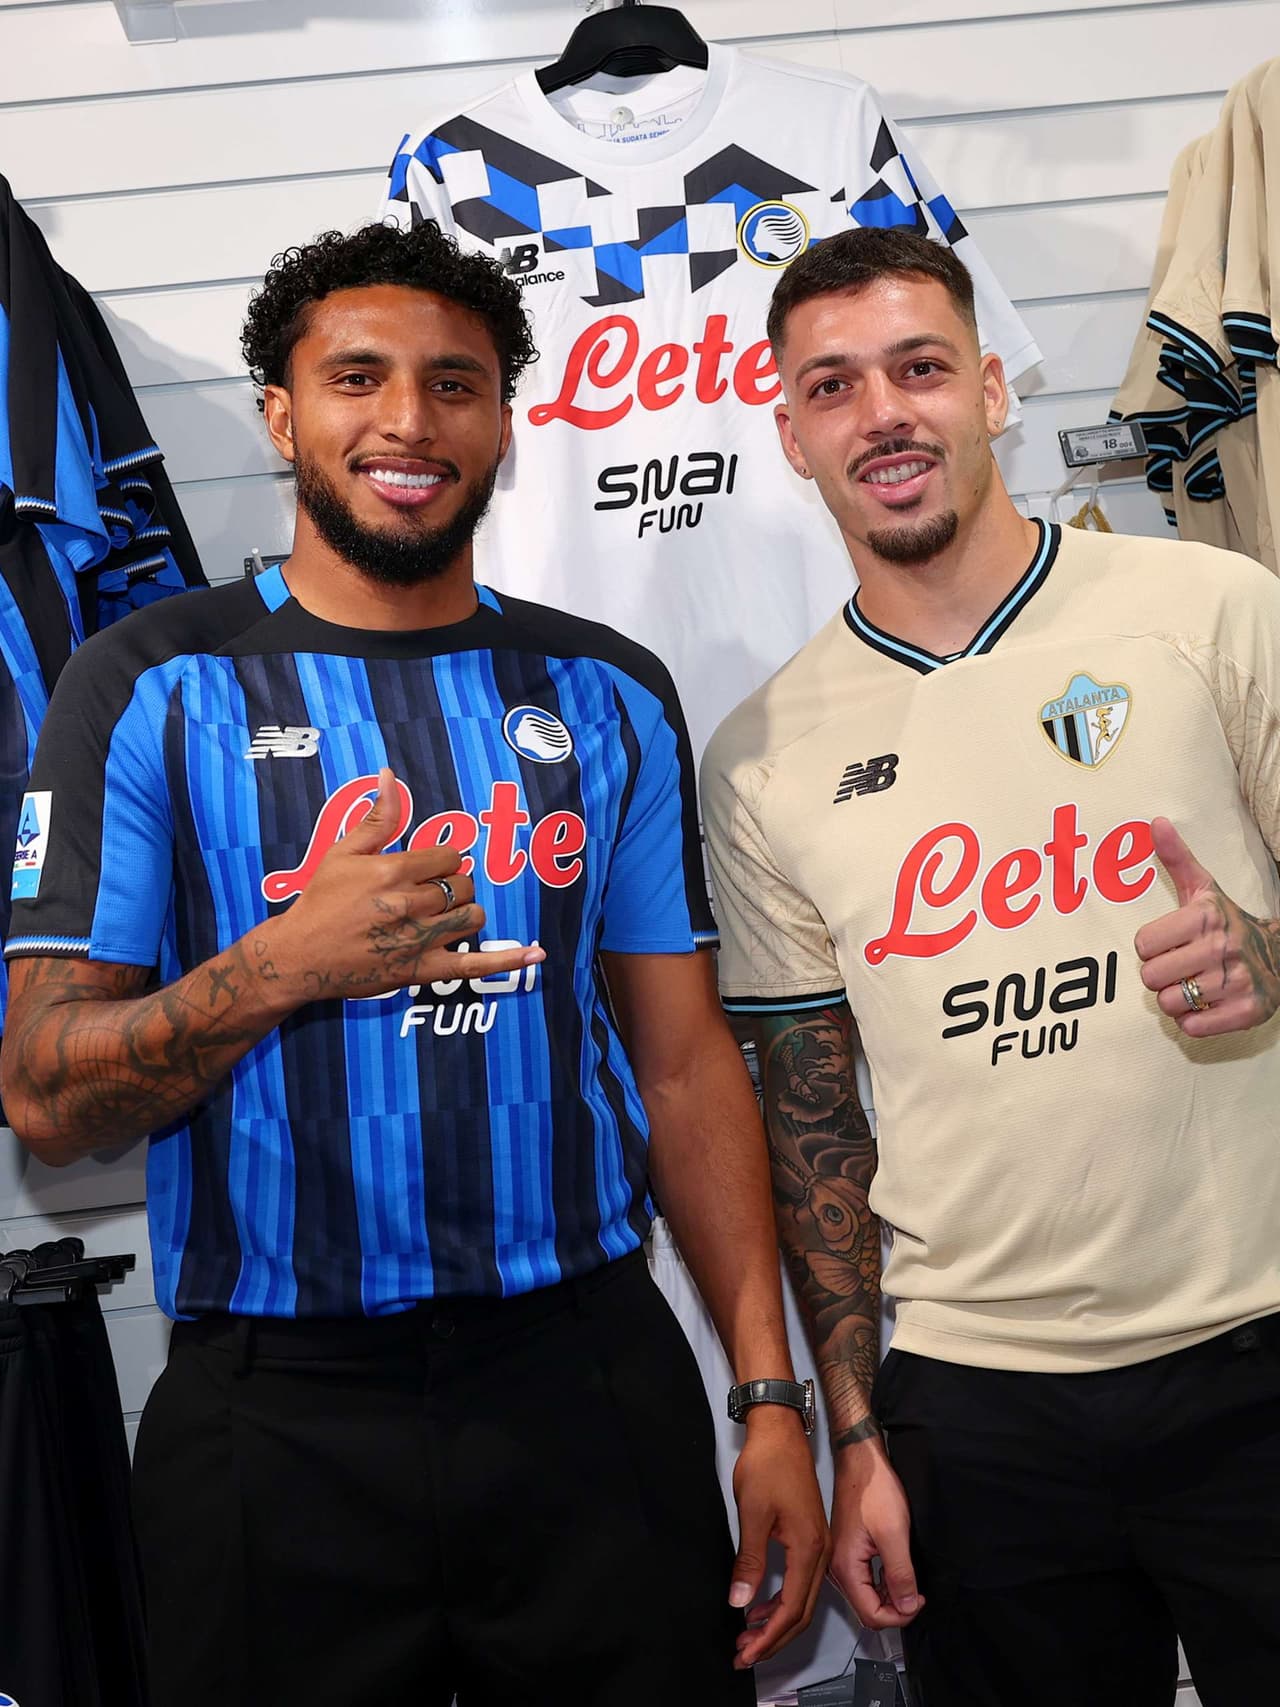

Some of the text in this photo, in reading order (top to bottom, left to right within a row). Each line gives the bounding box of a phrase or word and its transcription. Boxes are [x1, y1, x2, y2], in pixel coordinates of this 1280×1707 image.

[621, 134, 648, 143] SUDATA
[514, 270, 565, 288] alance
[528, 314, 782, 431] Lete
[1102, 438, 1118, 450] 18
[638, 502, 703, 538] FUN
[1048, 687, 1121, 717] ATALANTA
[31, 849, 37, 859] A
[863, 803, 1158, 967] Lete
[399, 1001, 498, 1038] FUN
[991, 1019, 1079, 1066] FUN
